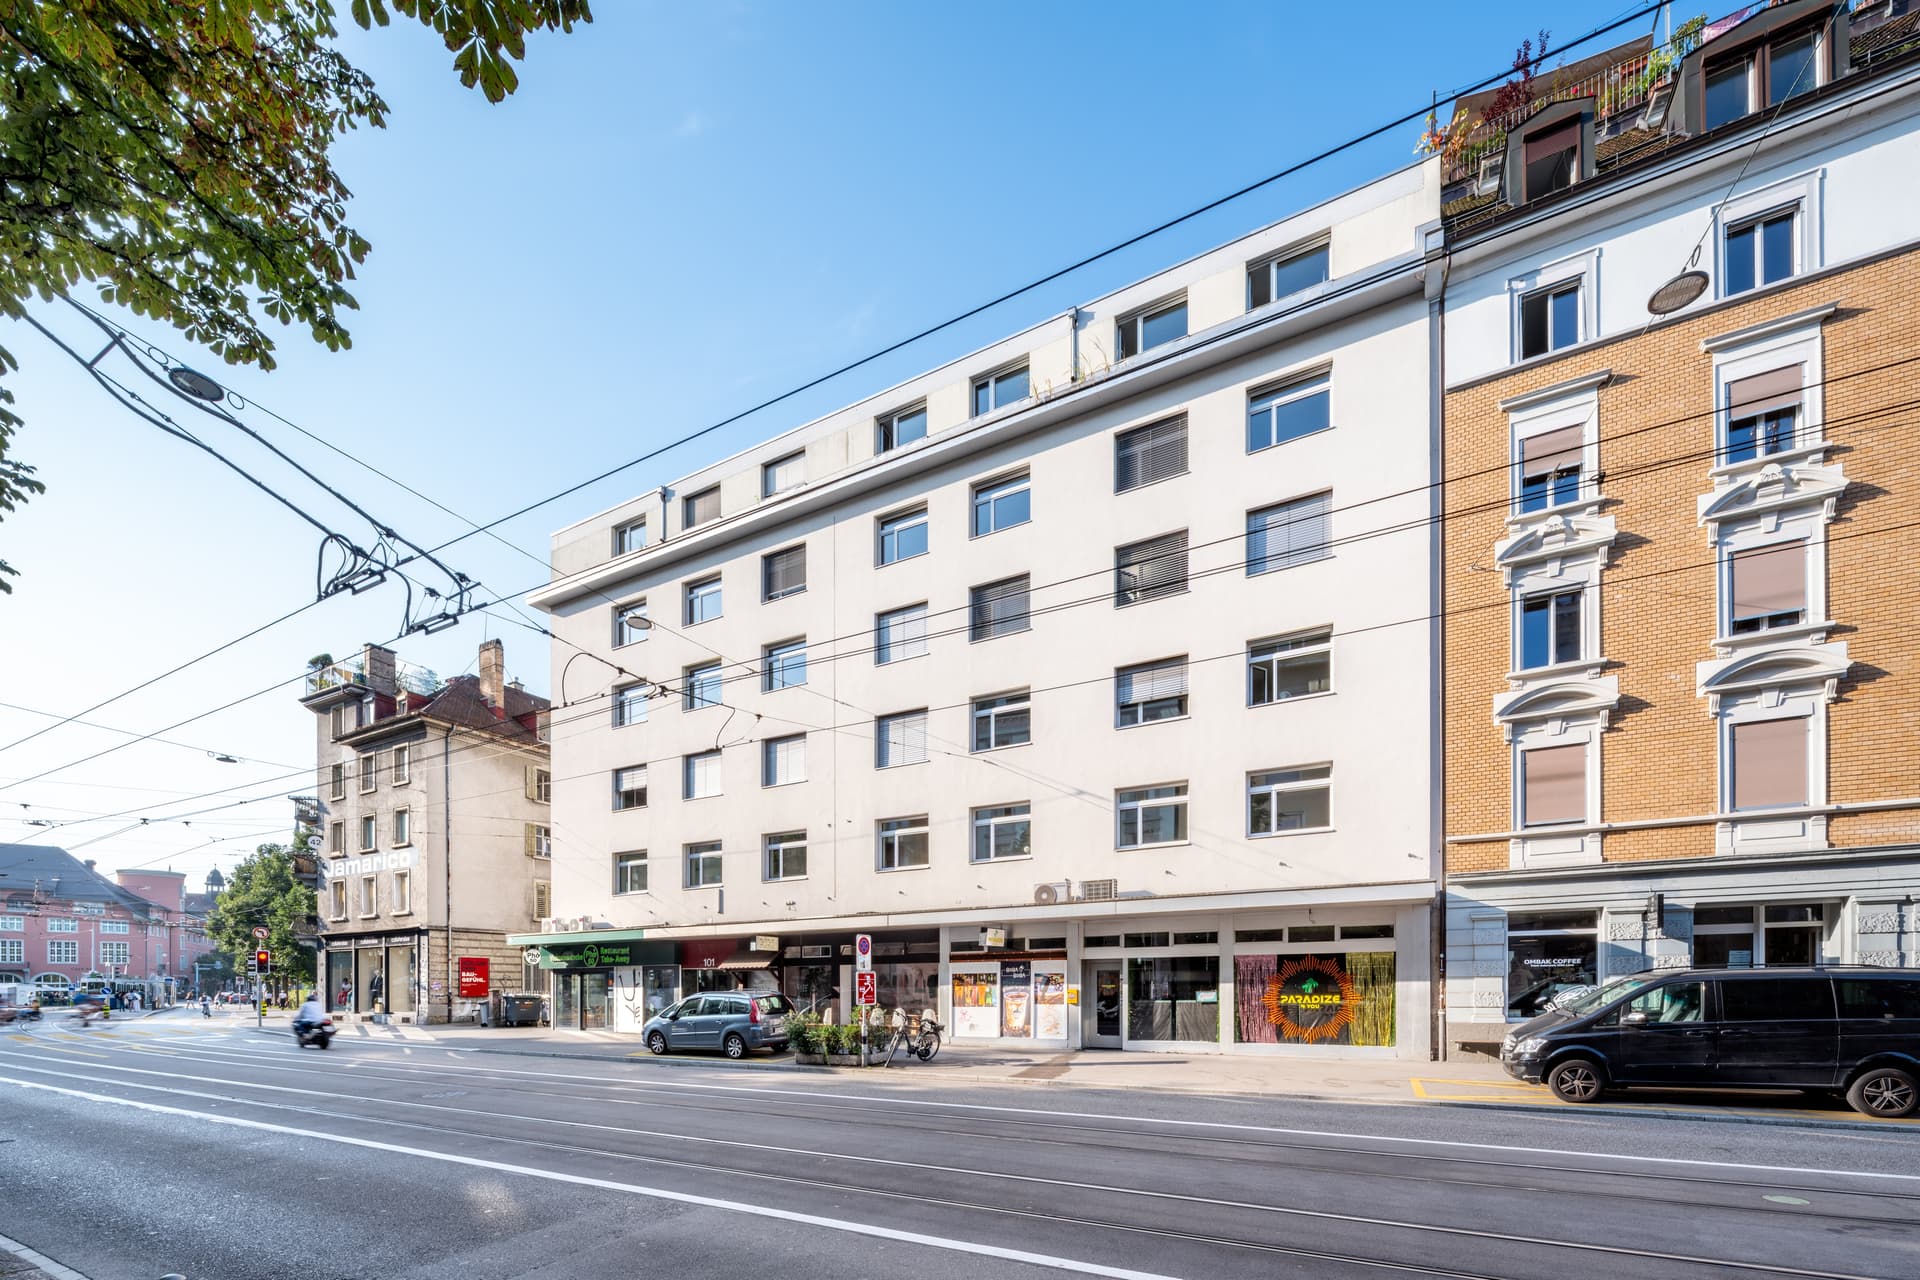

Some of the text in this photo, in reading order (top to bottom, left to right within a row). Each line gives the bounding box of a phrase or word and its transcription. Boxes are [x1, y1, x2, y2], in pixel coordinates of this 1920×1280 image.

[326, 851, 411, 877] Jamarico
[703, 958, 715, 967] 101
[1280, 994, 1341, 1004] PARADIZE
